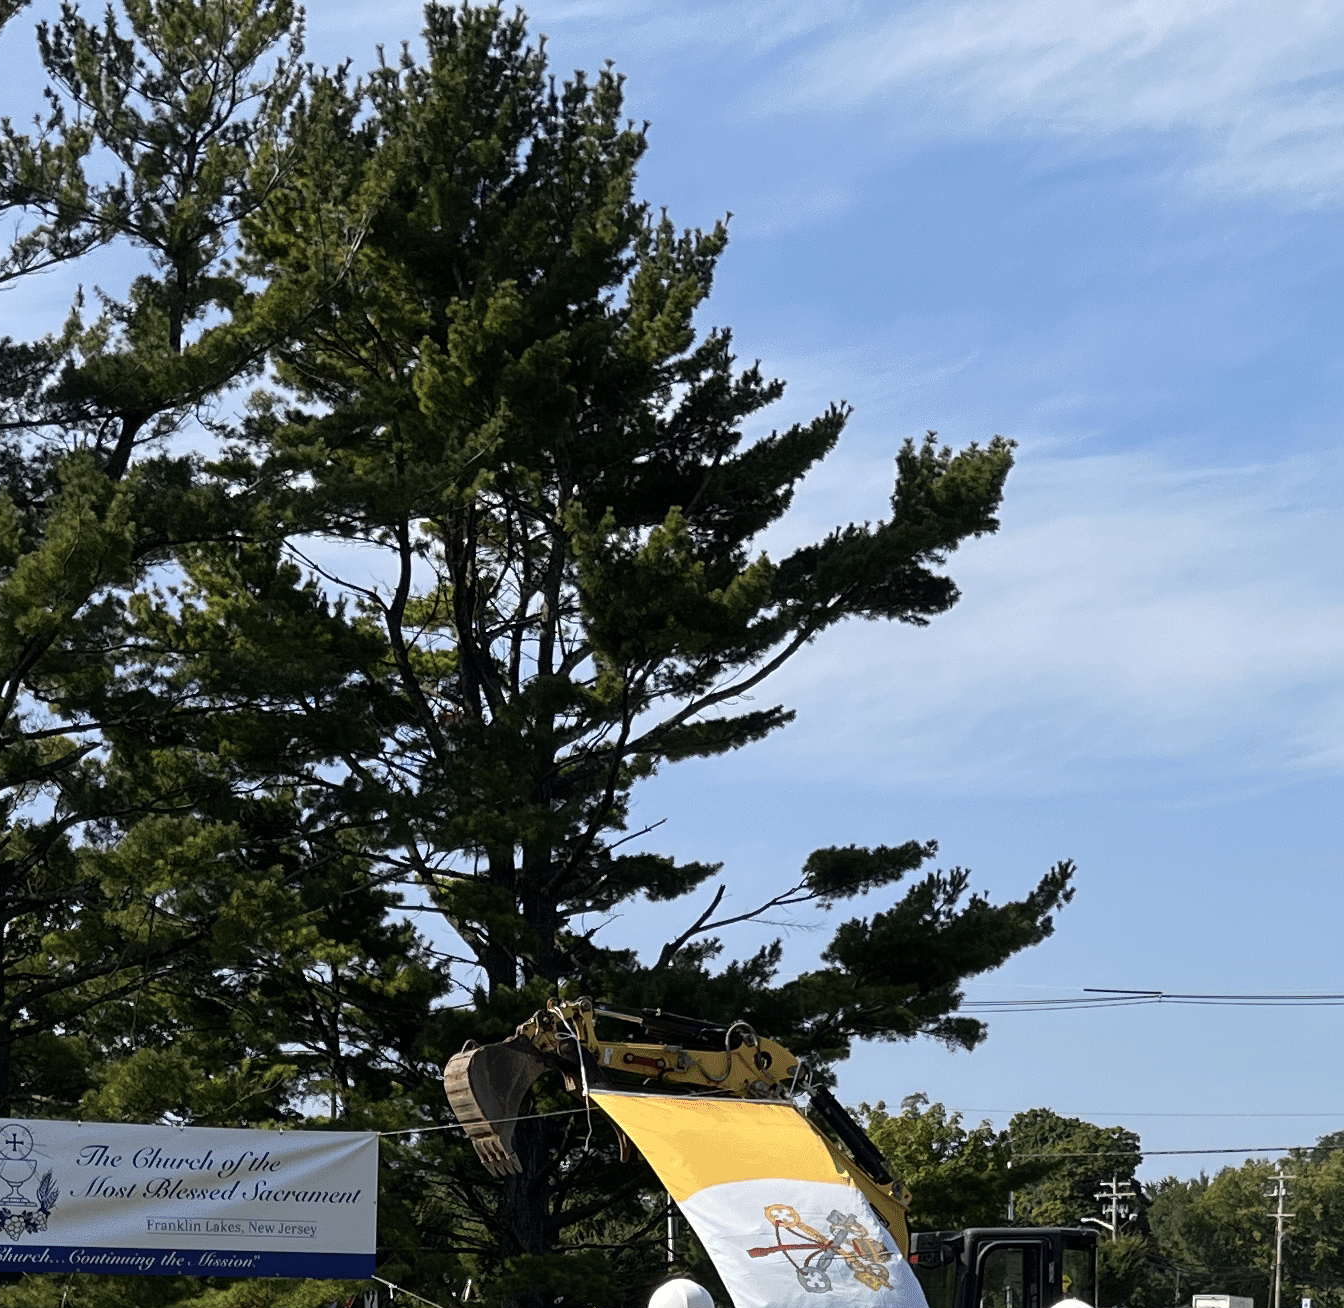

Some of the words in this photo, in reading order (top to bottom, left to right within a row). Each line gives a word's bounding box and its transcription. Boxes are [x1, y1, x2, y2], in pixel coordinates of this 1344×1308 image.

[76, 1144, 123, 1168] The
[132, 1146, 214, 1171] Church
[217, 1150, 254, 1179] of
[248, 1151, 283, 1173] the
[69, 1175, 138, 1199] Most
[142, 1177, 242, 1201] Blessed
[242, 1179, 363, 1204] Sacrament
[146, 1218, 202, 1233] Franklin
[205, 1219, 245, 1235] Lakes,
[248, 1220, 276, 1234] New
[277, 1221, 318, 1238] Jersey
[68, 1248, 157, 1272] Continuing
[160, 1250, 185, 1267] the
